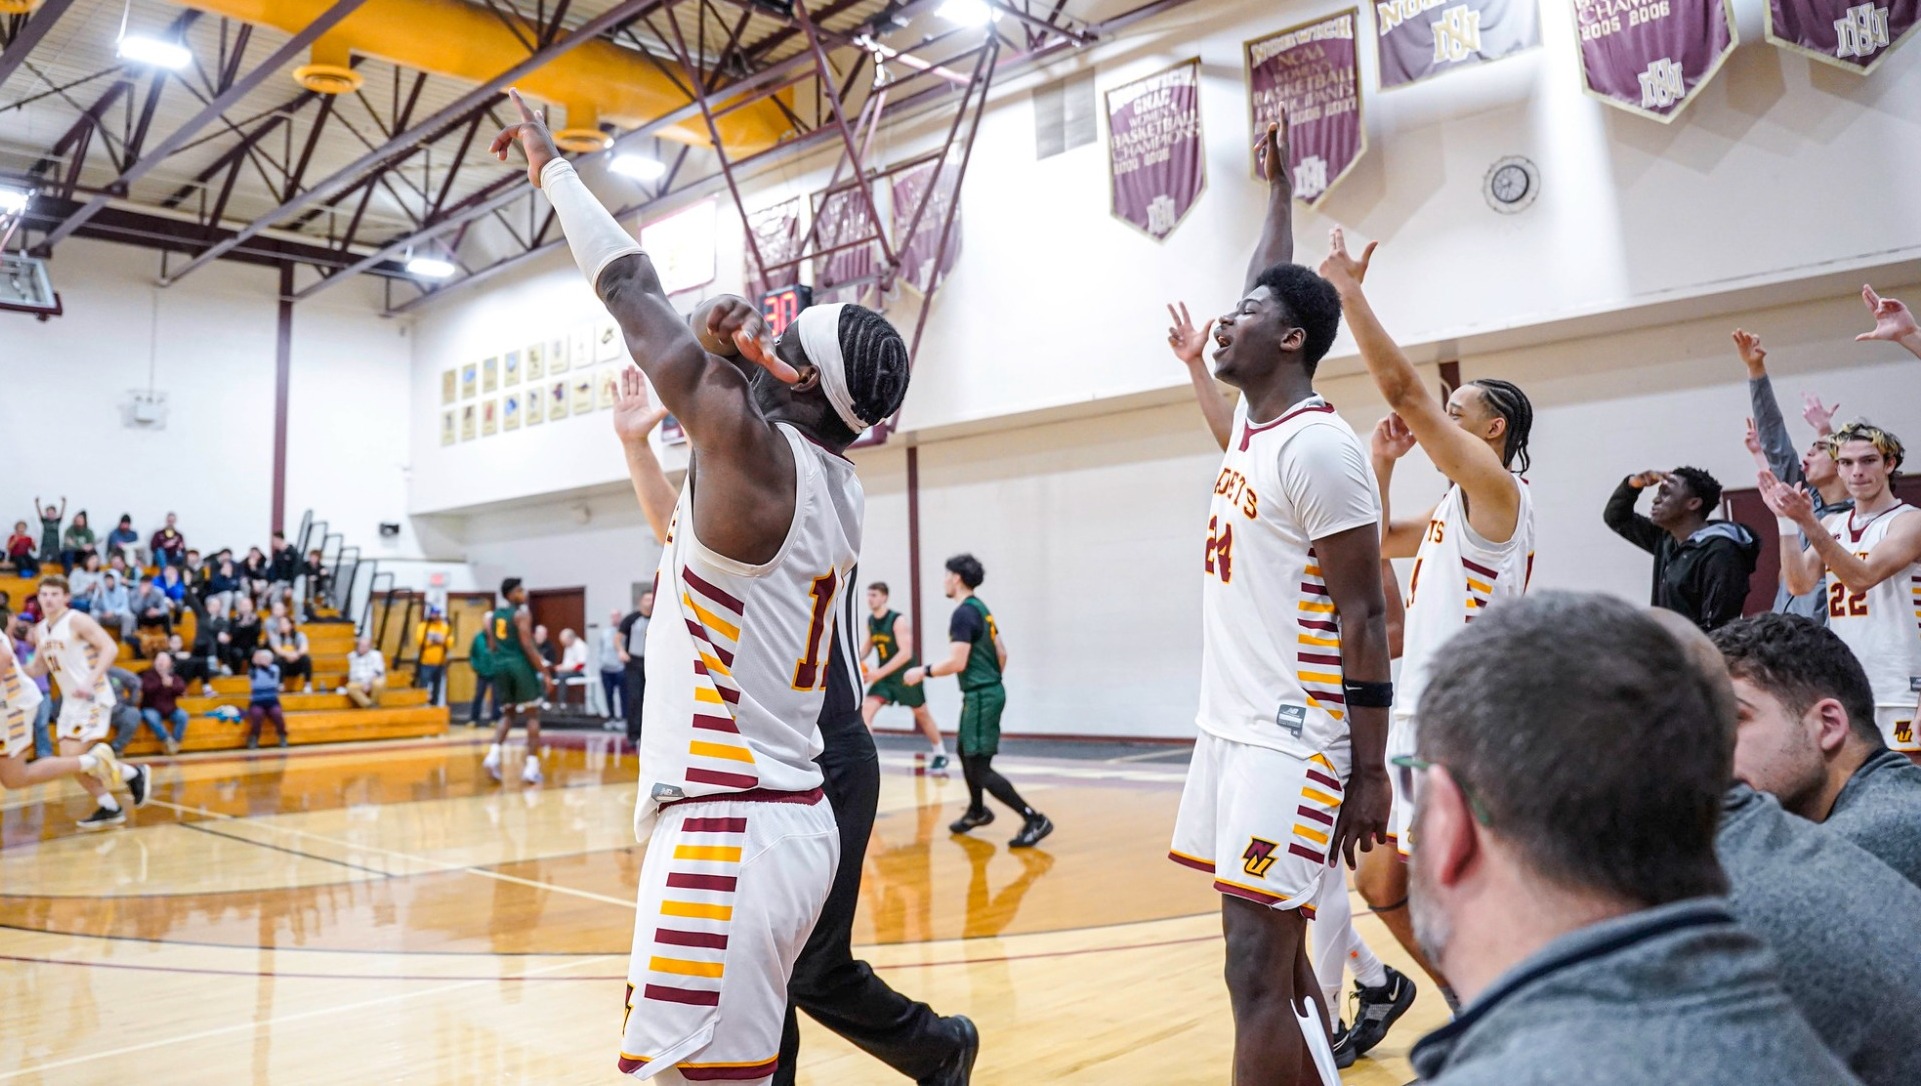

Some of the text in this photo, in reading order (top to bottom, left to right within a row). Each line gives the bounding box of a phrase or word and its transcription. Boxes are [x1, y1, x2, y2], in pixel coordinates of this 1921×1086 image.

[1204, 514, 1233, 584] 24
[1830, 582, 1868, 618] 22
[1240, 834, 1280, 880] NU
